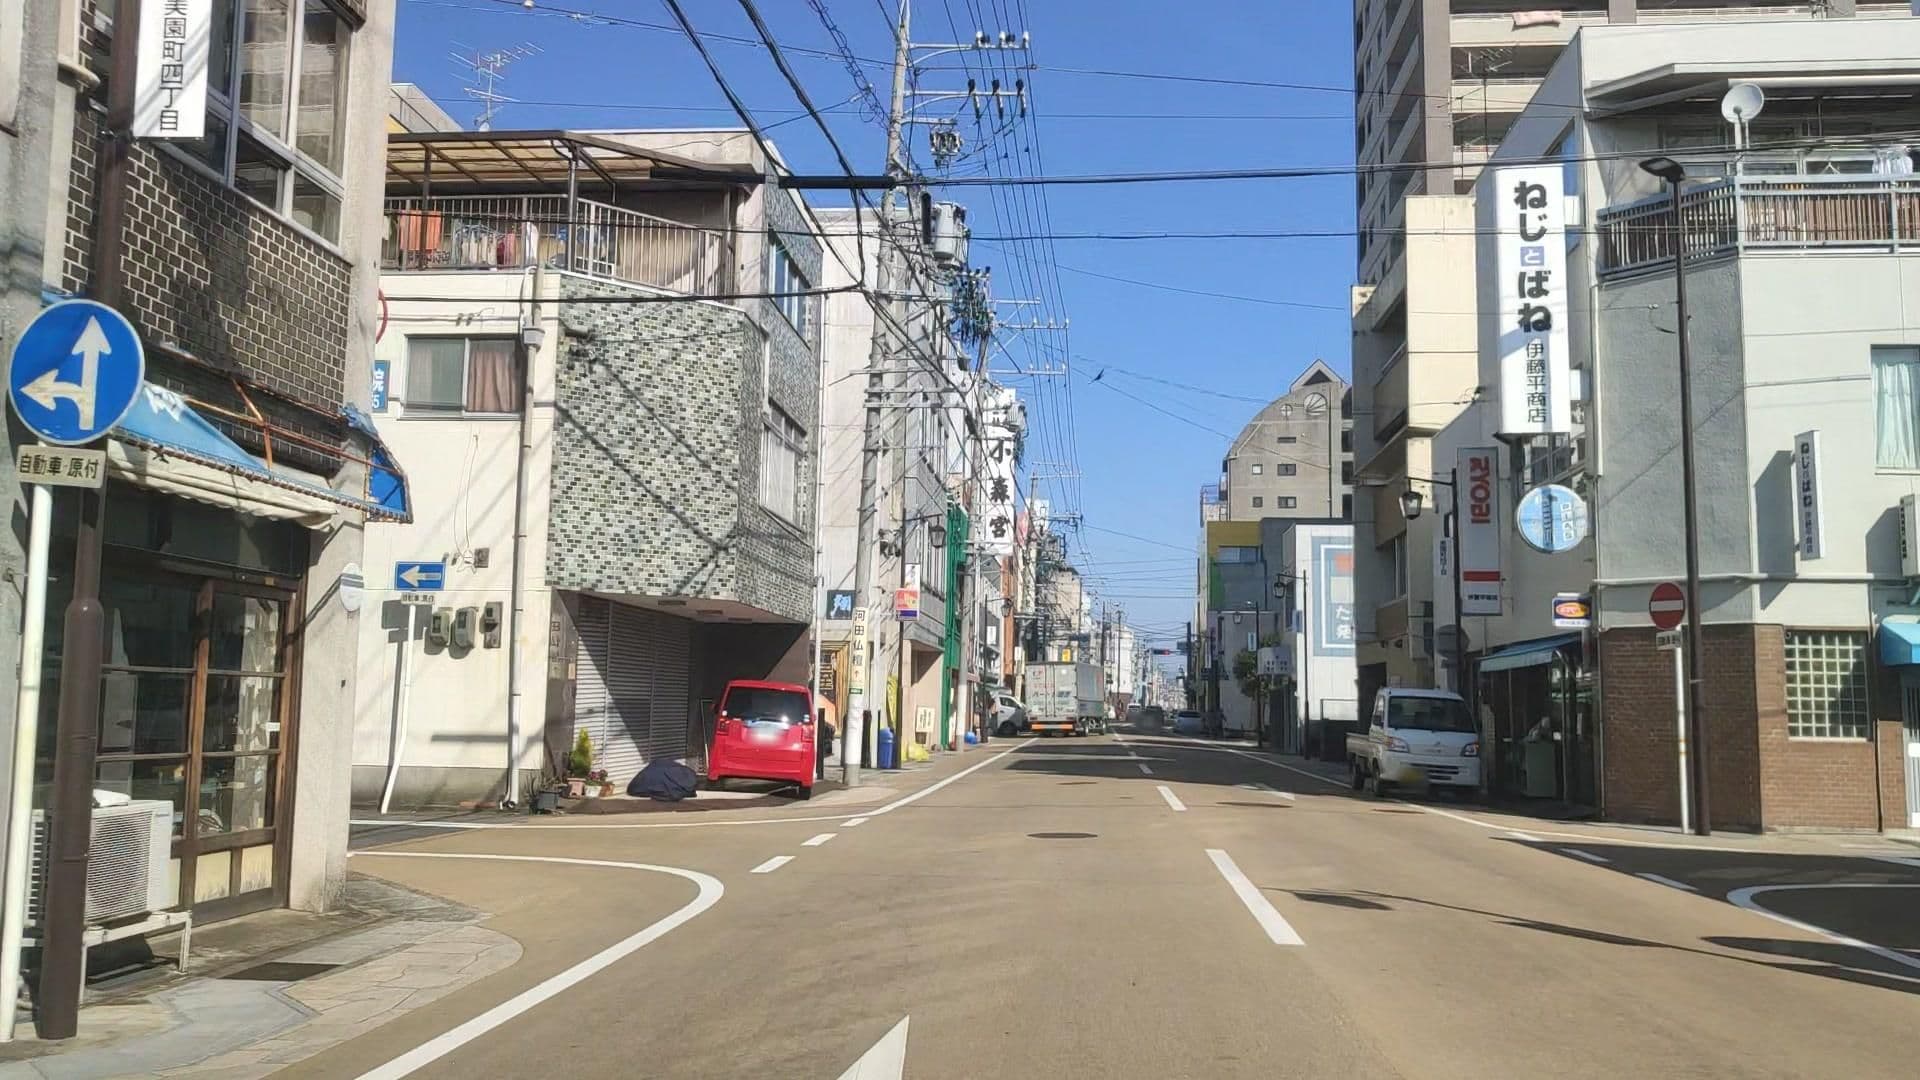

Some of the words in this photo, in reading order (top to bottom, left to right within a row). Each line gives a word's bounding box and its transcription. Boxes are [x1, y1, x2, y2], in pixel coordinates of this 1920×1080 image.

[1514, 181, 1552, 333] ねじとばね
[1526, 342, 1546, 424] 伊藤平商店
[1470, 456, 1491, 524] RYOBI
